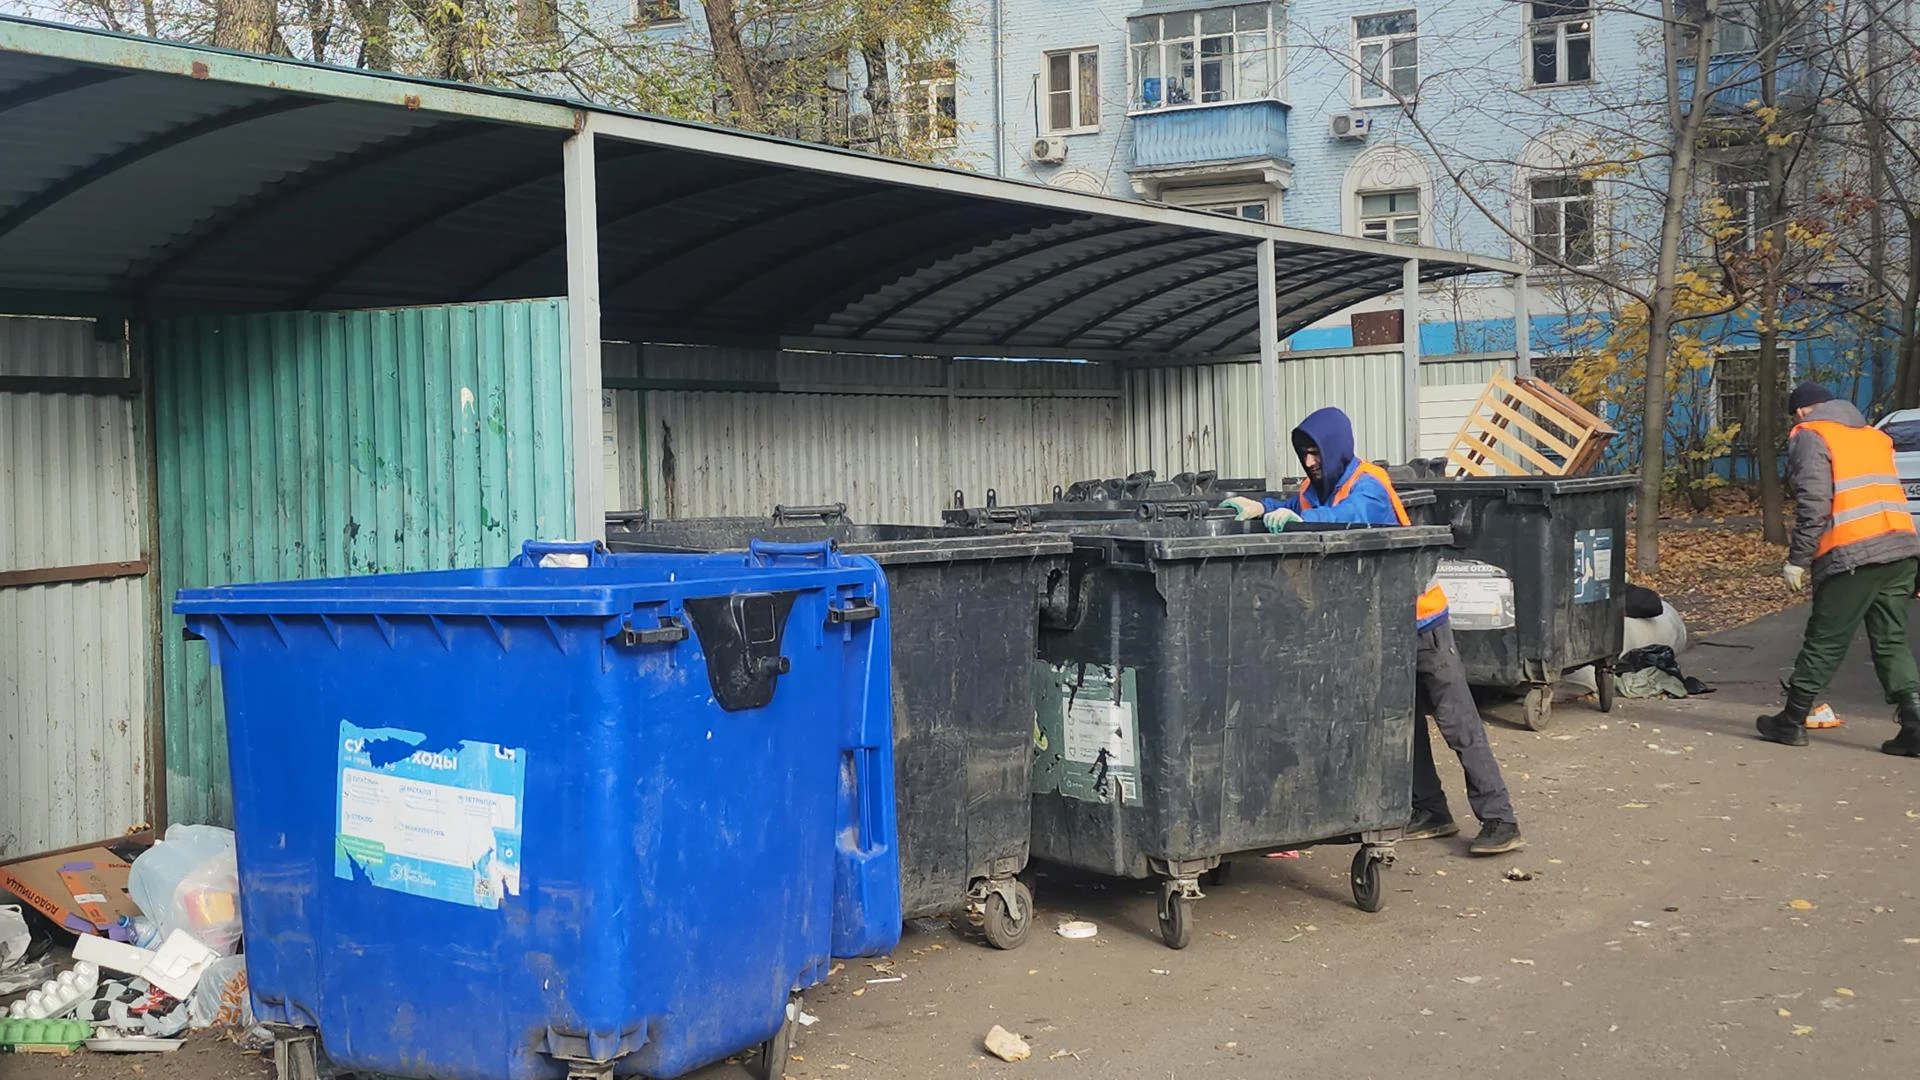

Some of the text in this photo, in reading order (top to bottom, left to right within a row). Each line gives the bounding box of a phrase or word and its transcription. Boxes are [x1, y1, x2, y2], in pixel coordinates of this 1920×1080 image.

[411, 750, 457, 771] ХОДЫ
[6, 876, 59, 916] ДОДО ПИЦЦА
